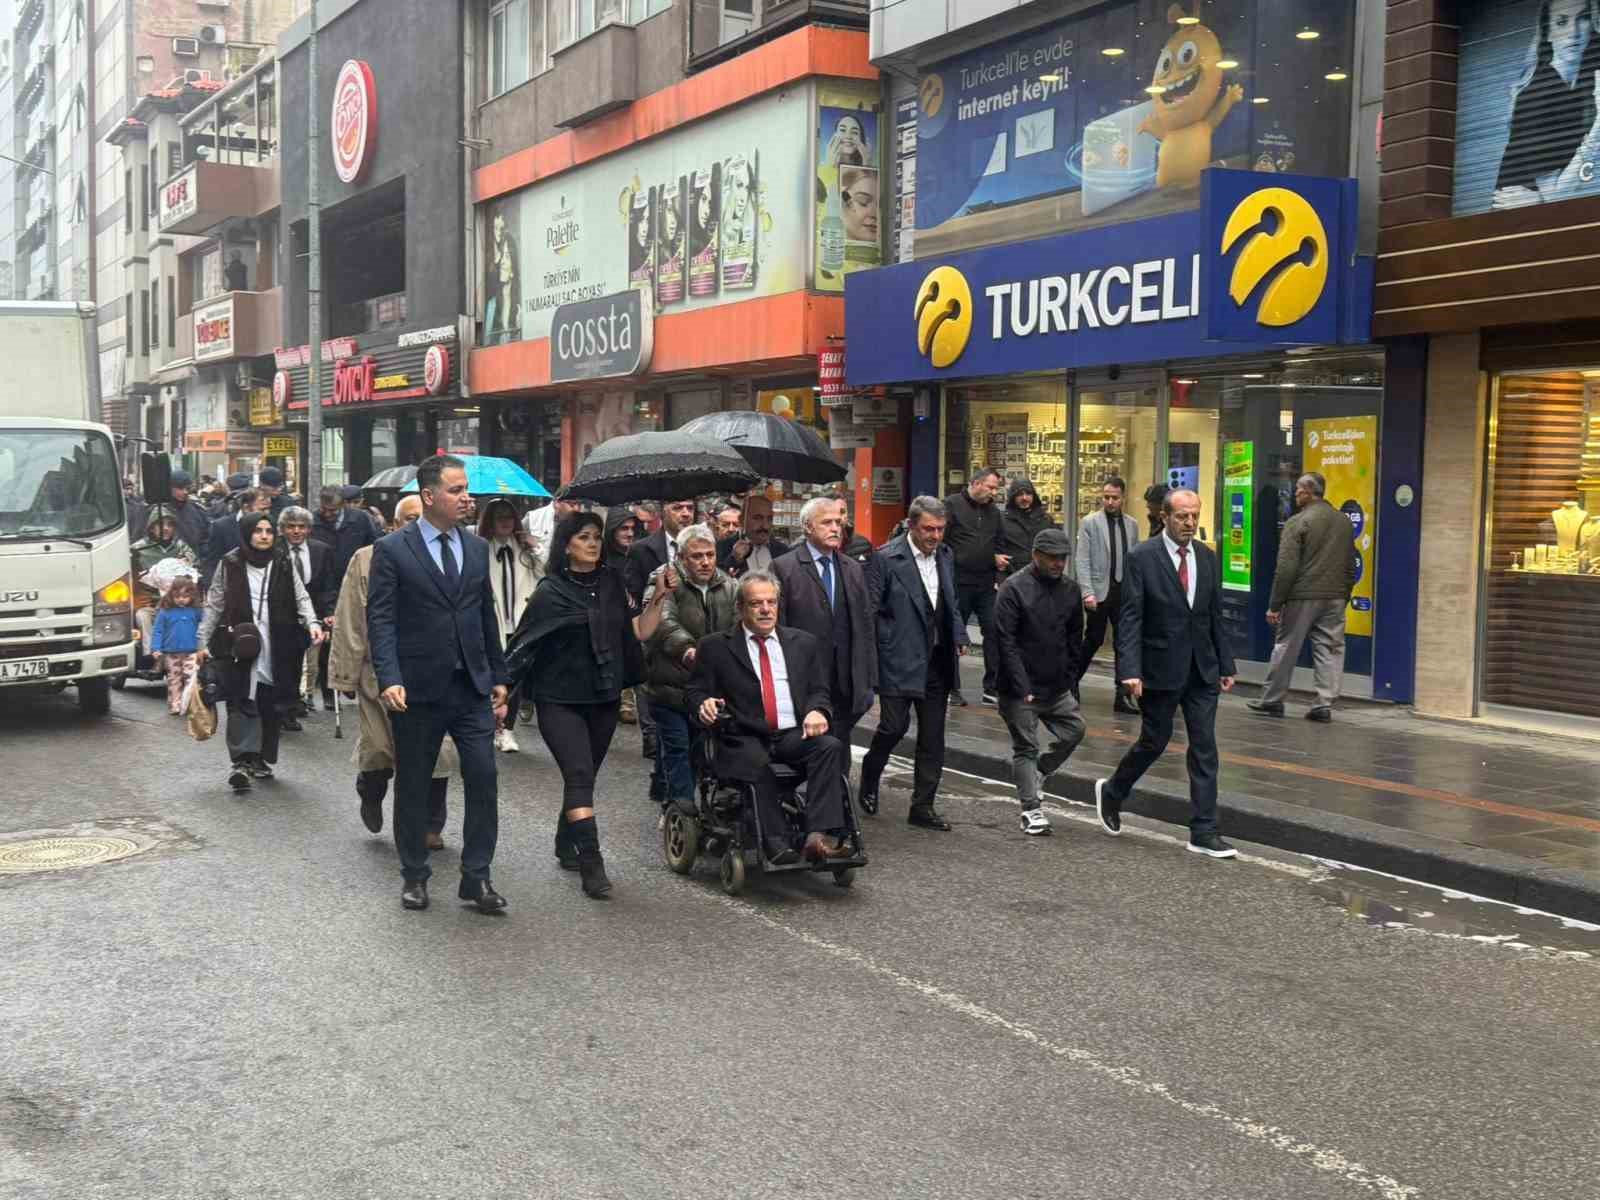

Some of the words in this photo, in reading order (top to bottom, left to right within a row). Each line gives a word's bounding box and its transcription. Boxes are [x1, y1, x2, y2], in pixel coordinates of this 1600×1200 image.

[1033, 36, 1073, 66] evde
[958, 85, 1018, 120] internet
[546, 221, 580, 249] Palette
[558, 304, 632, 361] cossta
[14, 661, 46, 676] 7478
